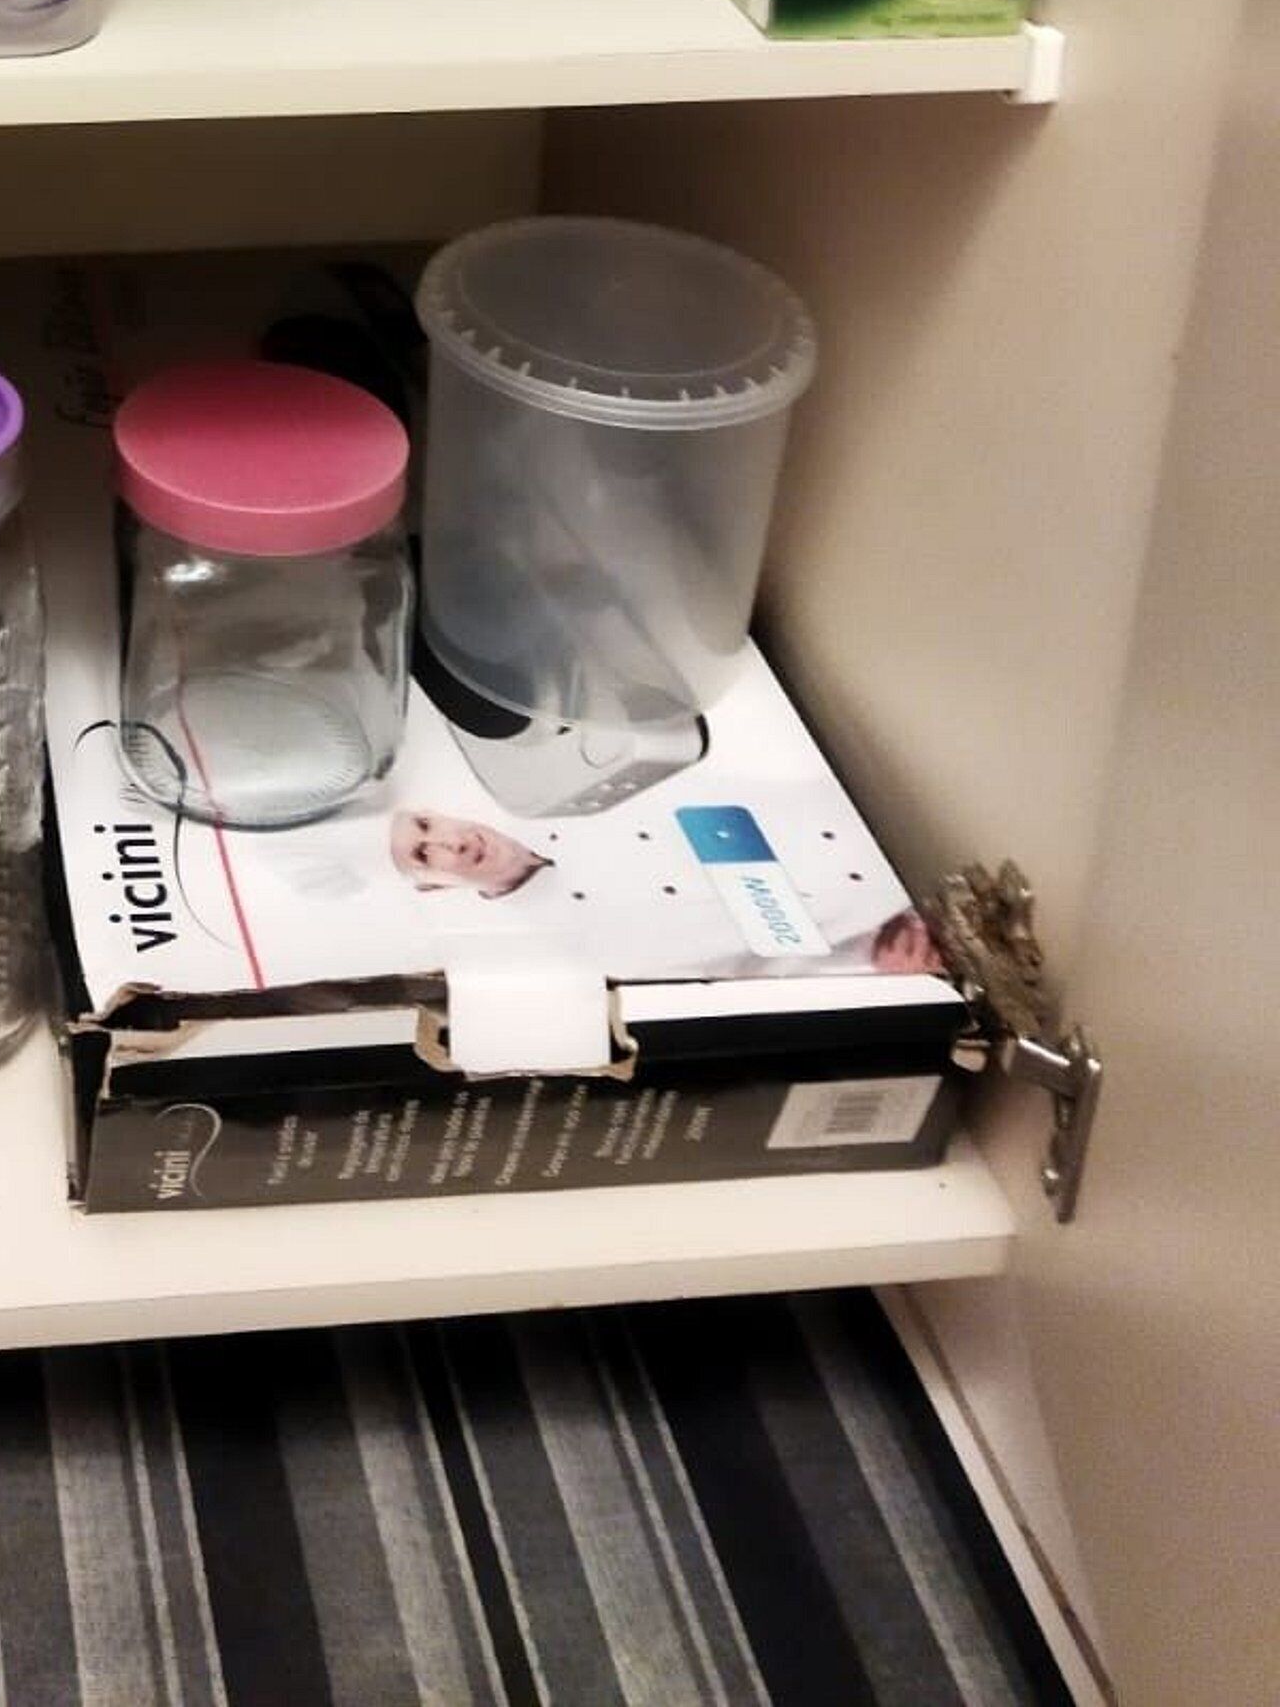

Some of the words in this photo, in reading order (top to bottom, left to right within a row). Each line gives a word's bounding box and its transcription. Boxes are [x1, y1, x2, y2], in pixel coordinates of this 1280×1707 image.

[93, 823, 178, 953] vicini
[739, 877, 802, 945] 2000W
[145, 1149, 192, 1199] vicini
